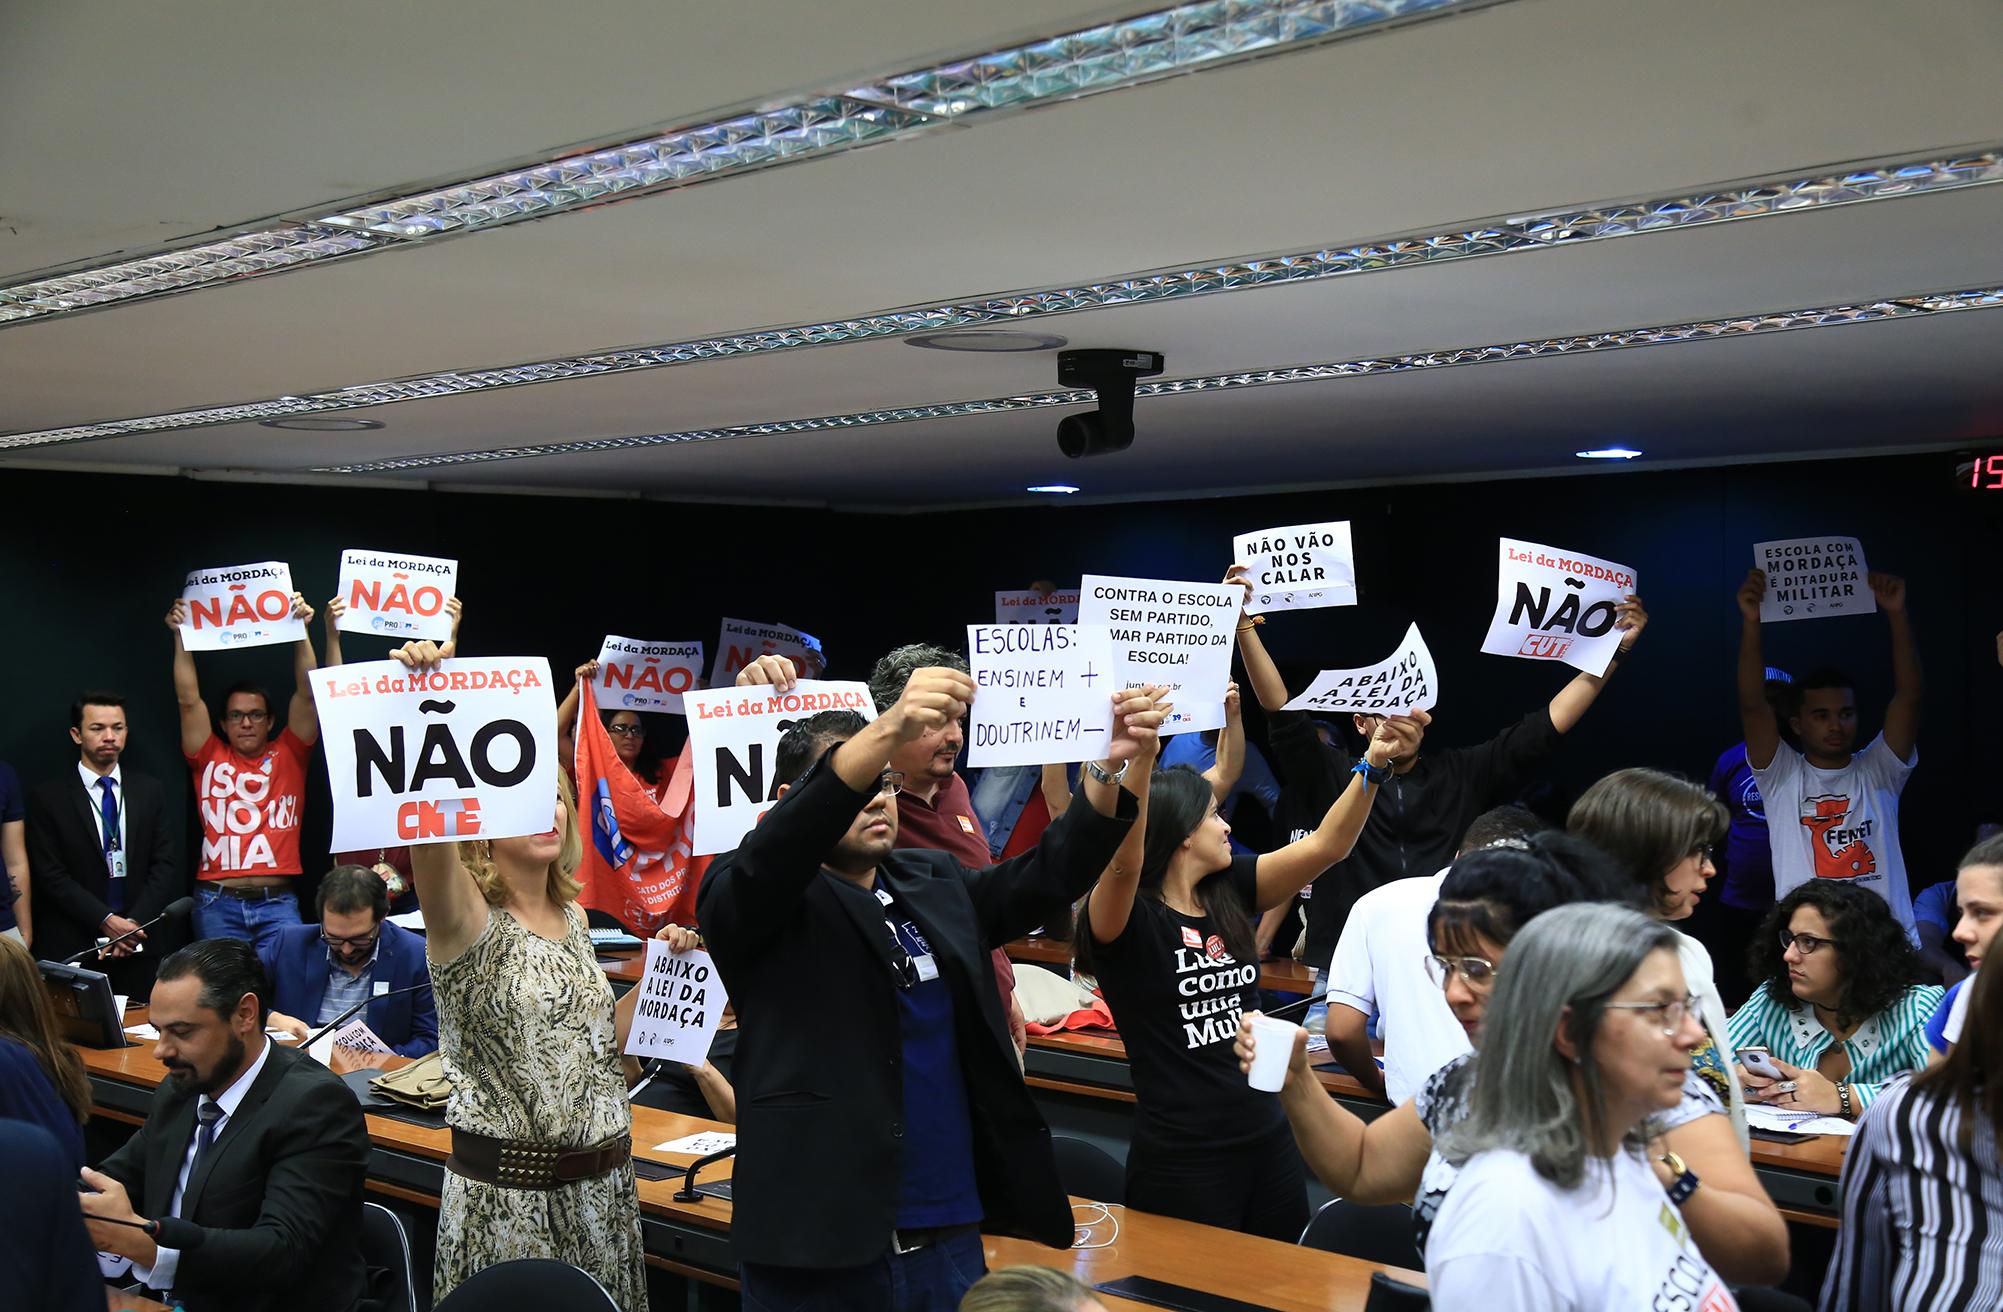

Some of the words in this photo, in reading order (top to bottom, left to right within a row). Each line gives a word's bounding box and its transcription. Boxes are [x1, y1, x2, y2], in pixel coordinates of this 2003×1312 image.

[1247, 537, 1286, 555] NÃO
[1295, 532, 1334, 549] VÃO
[1765, 545, 1821, 558] ESCOLA
[1826, 543, 1853, 553] COM
[348, 556, 367, 565] Lei
[369, 558, 384, 567] da
[387, 560, 451, 576] MORDAÇA
[1271, 552, 1312, 567] NOS
[1508, 548, 1533, 563] Lei
[1536, 553, 1555, 569] da
[1558, 557, 1633, 588] MORDAÇA
[1767, 554, 1857, 573] MORDAÇA
[201, 571, 218, 585] da
[1261, 567, 1325, 585] CALAR
[1771, 576, 1777, 588] É
[1784, 572, 1858, 587] DITADURA
[350, 572, 443, 617] NÃO
[1001, 597, 1020, 606] Lei
[1023, 597, 1036, 605] da
[1039, 594, 1080, 605] MORD
[1094, 587, 1157, 605] CONTRA
[1162, 592, 1173, 604] O
[1178, 593, 1233, 608] ESCOLA
[1777, 584, 1854, 602] MILITAR
[190, 584, 290, 630] NÃO
[1109, 608, 1143, 623] SEM
[1146, 611, 1214, 628] PARTIDO,
[1508, 577, 1617, 638] NÃO
[727, 624, 743, 633] Lei
[744, 627, 756, 636] da
[976, 626, 1077, 654] ESCOLAS:
[1146, 631, 1207, 646] PARTIDO
[1211, 635, 1228, 646] DA
[606, 641, 621, 651] Lei
[624, 644, 638, 653] da
[641, 646, 699, 658] MORDAÇA
[1127, 651, 1189, 665] ESCOLA!
[1519, 634, 1567, 658] CUT
[604, 658, 693, 694] NÃO
[977, 670, 1064, 688] ENSINEM
[1338, 651, 1417, 687] ABAIXO
[327, 676, 371, 697] Lei
[376, 674, 404, 694] da
[409, 670, 541, 695] MORDAÇA
[1323, 689, 1338, 697] A
[1350, 684, 1392, 698] LEI
[1401, 668, 1424, 692] DA
[697, 699, 732, 719] Lei
[737, 695, 763, 715] da
[1020, 697, 1026, 708] E
[1307, 684, 1427, 708] MORDAÇA
[353, 700, 537, 798] NÃO
[202, 799, 261, 834] NO
[397, 797, 482, 840] CNTE
[202, 834, 277, 871] MIA
[647, 885, 682, 904] DISTRIT
[659, 875, 675, 890] DOS
[653, 956, 709, 982] ABAIXO
[1179, 964, 1256, 996] como
[646, 977, 653, 994] A
[656, 978, 674, 998] LEI
[679, 984, 706, 1006] DA
[639, 999, 705, 1028] MORDAÇA
[1179, 993, 1241, 1020] uma
